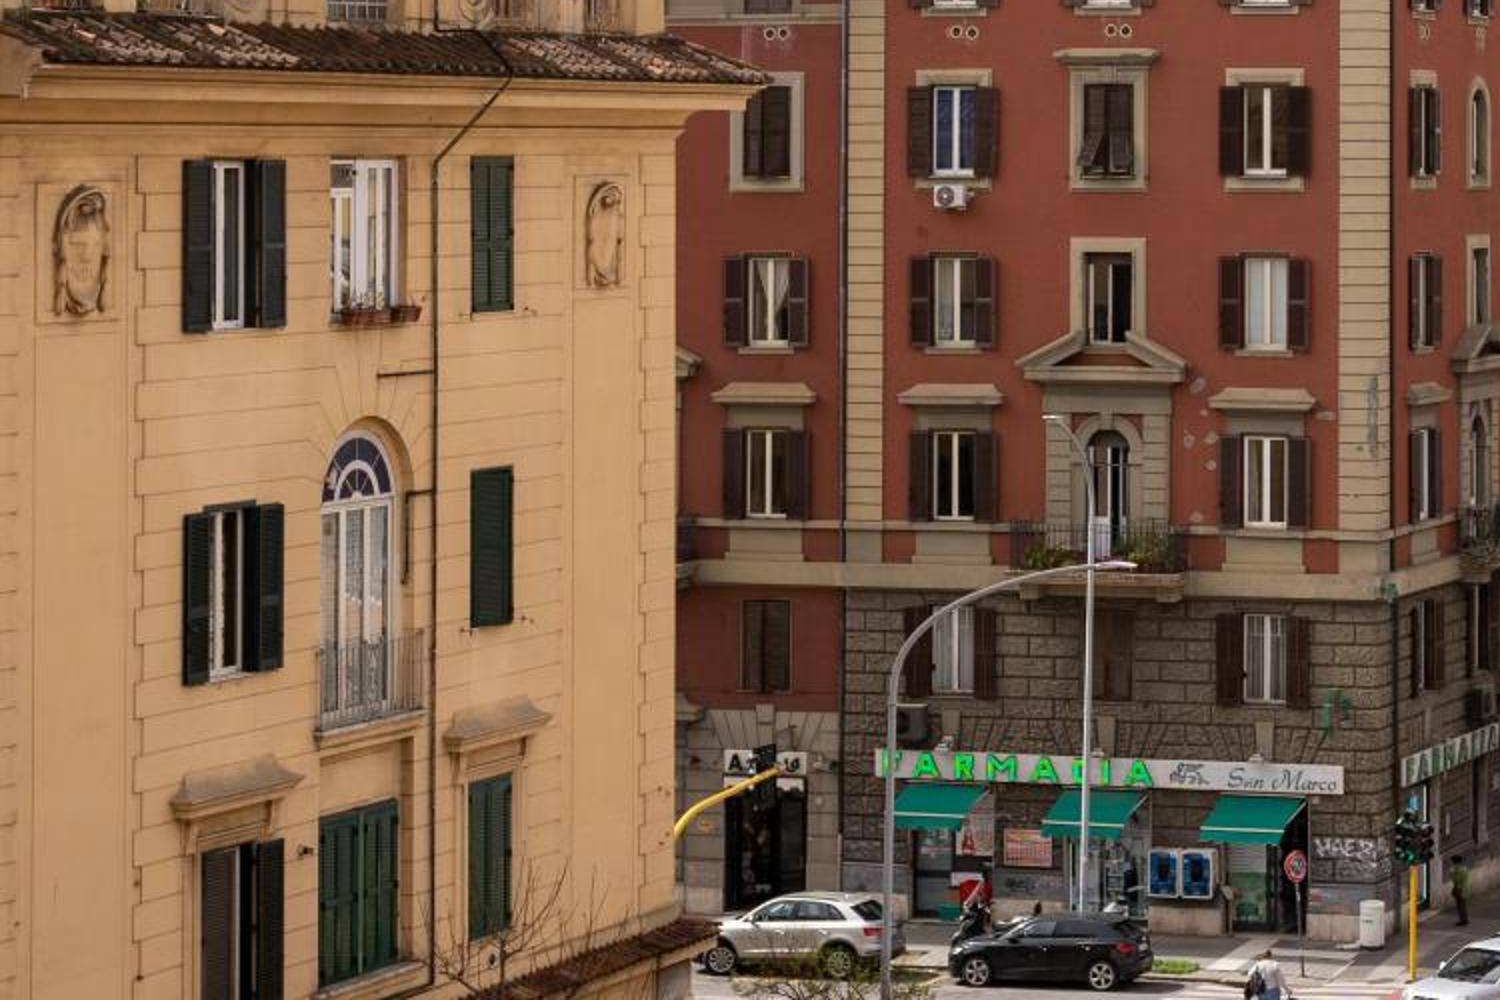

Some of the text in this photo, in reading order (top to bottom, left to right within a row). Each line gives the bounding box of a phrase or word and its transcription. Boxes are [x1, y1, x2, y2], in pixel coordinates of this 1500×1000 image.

[881, 750, 1337, 791] FARMACIA San Marco
